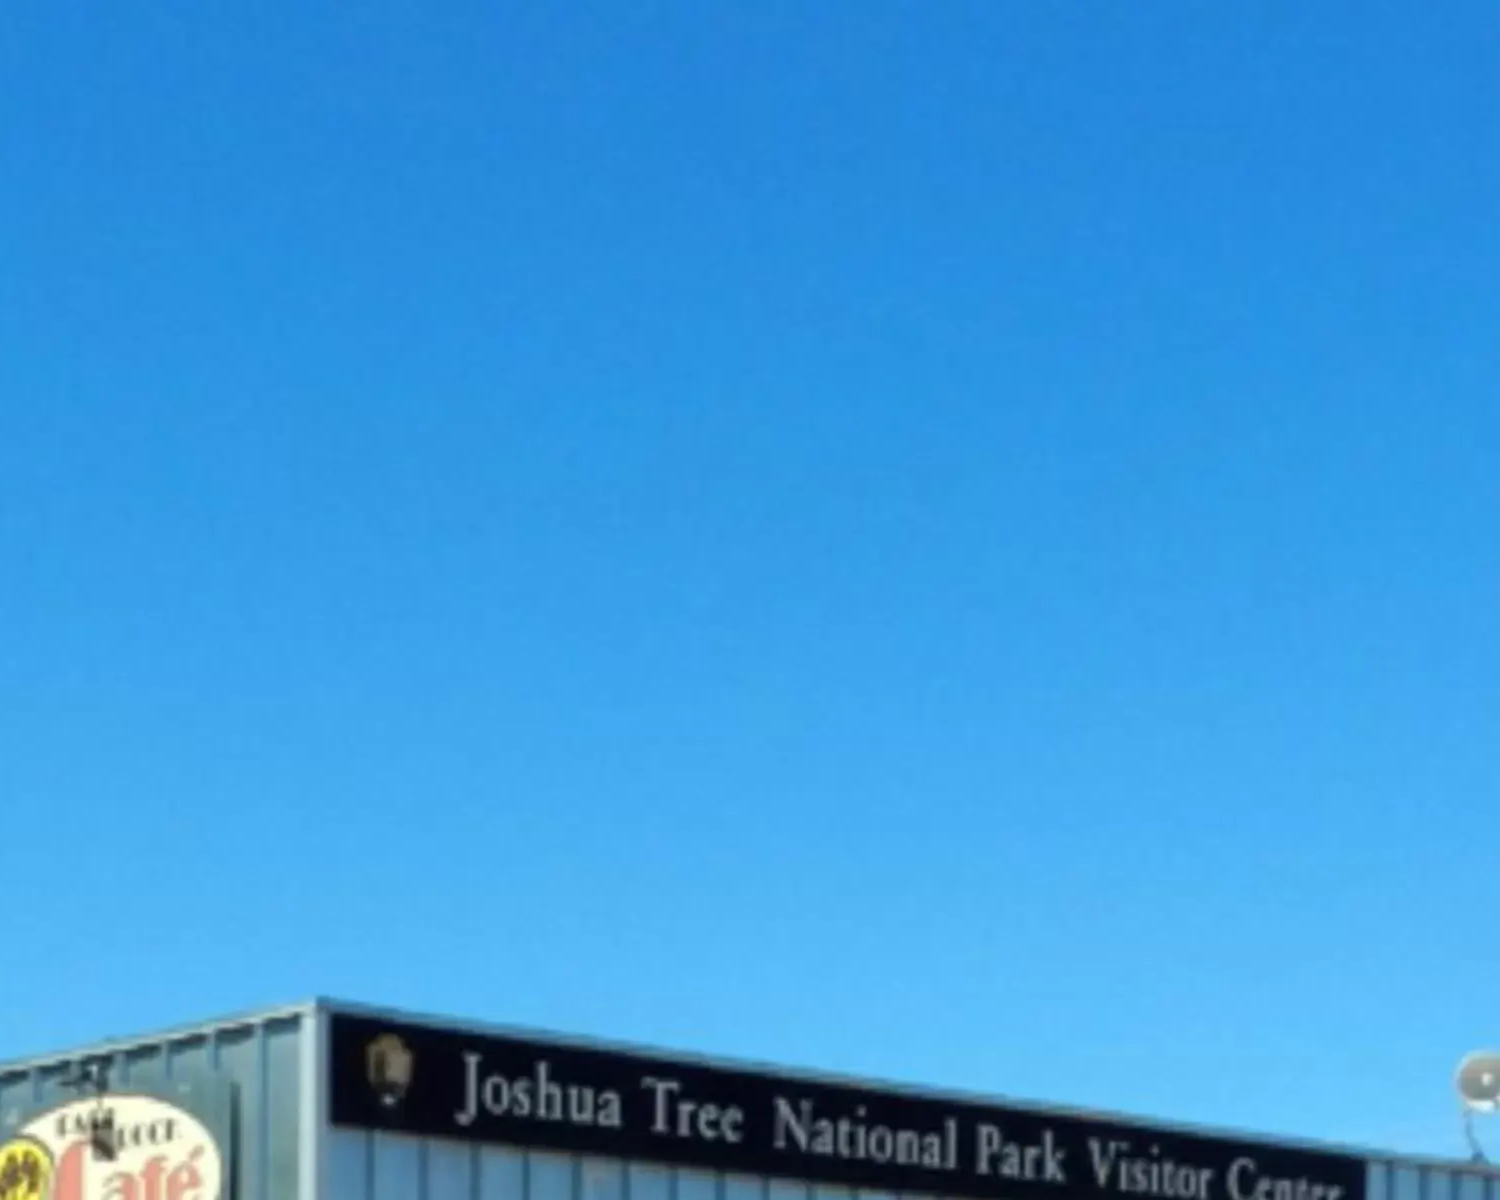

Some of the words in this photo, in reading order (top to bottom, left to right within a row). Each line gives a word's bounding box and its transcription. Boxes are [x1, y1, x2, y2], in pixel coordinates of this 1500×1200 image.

[454, 1050, 623, 1127] Joshua
[642, 1077, 744, 1142] Tree
[772, 1096, 959, 1170] National
[976, 1123, 1067, 1182] Park
[1089, 1136, 1216, 1200] Visitor
